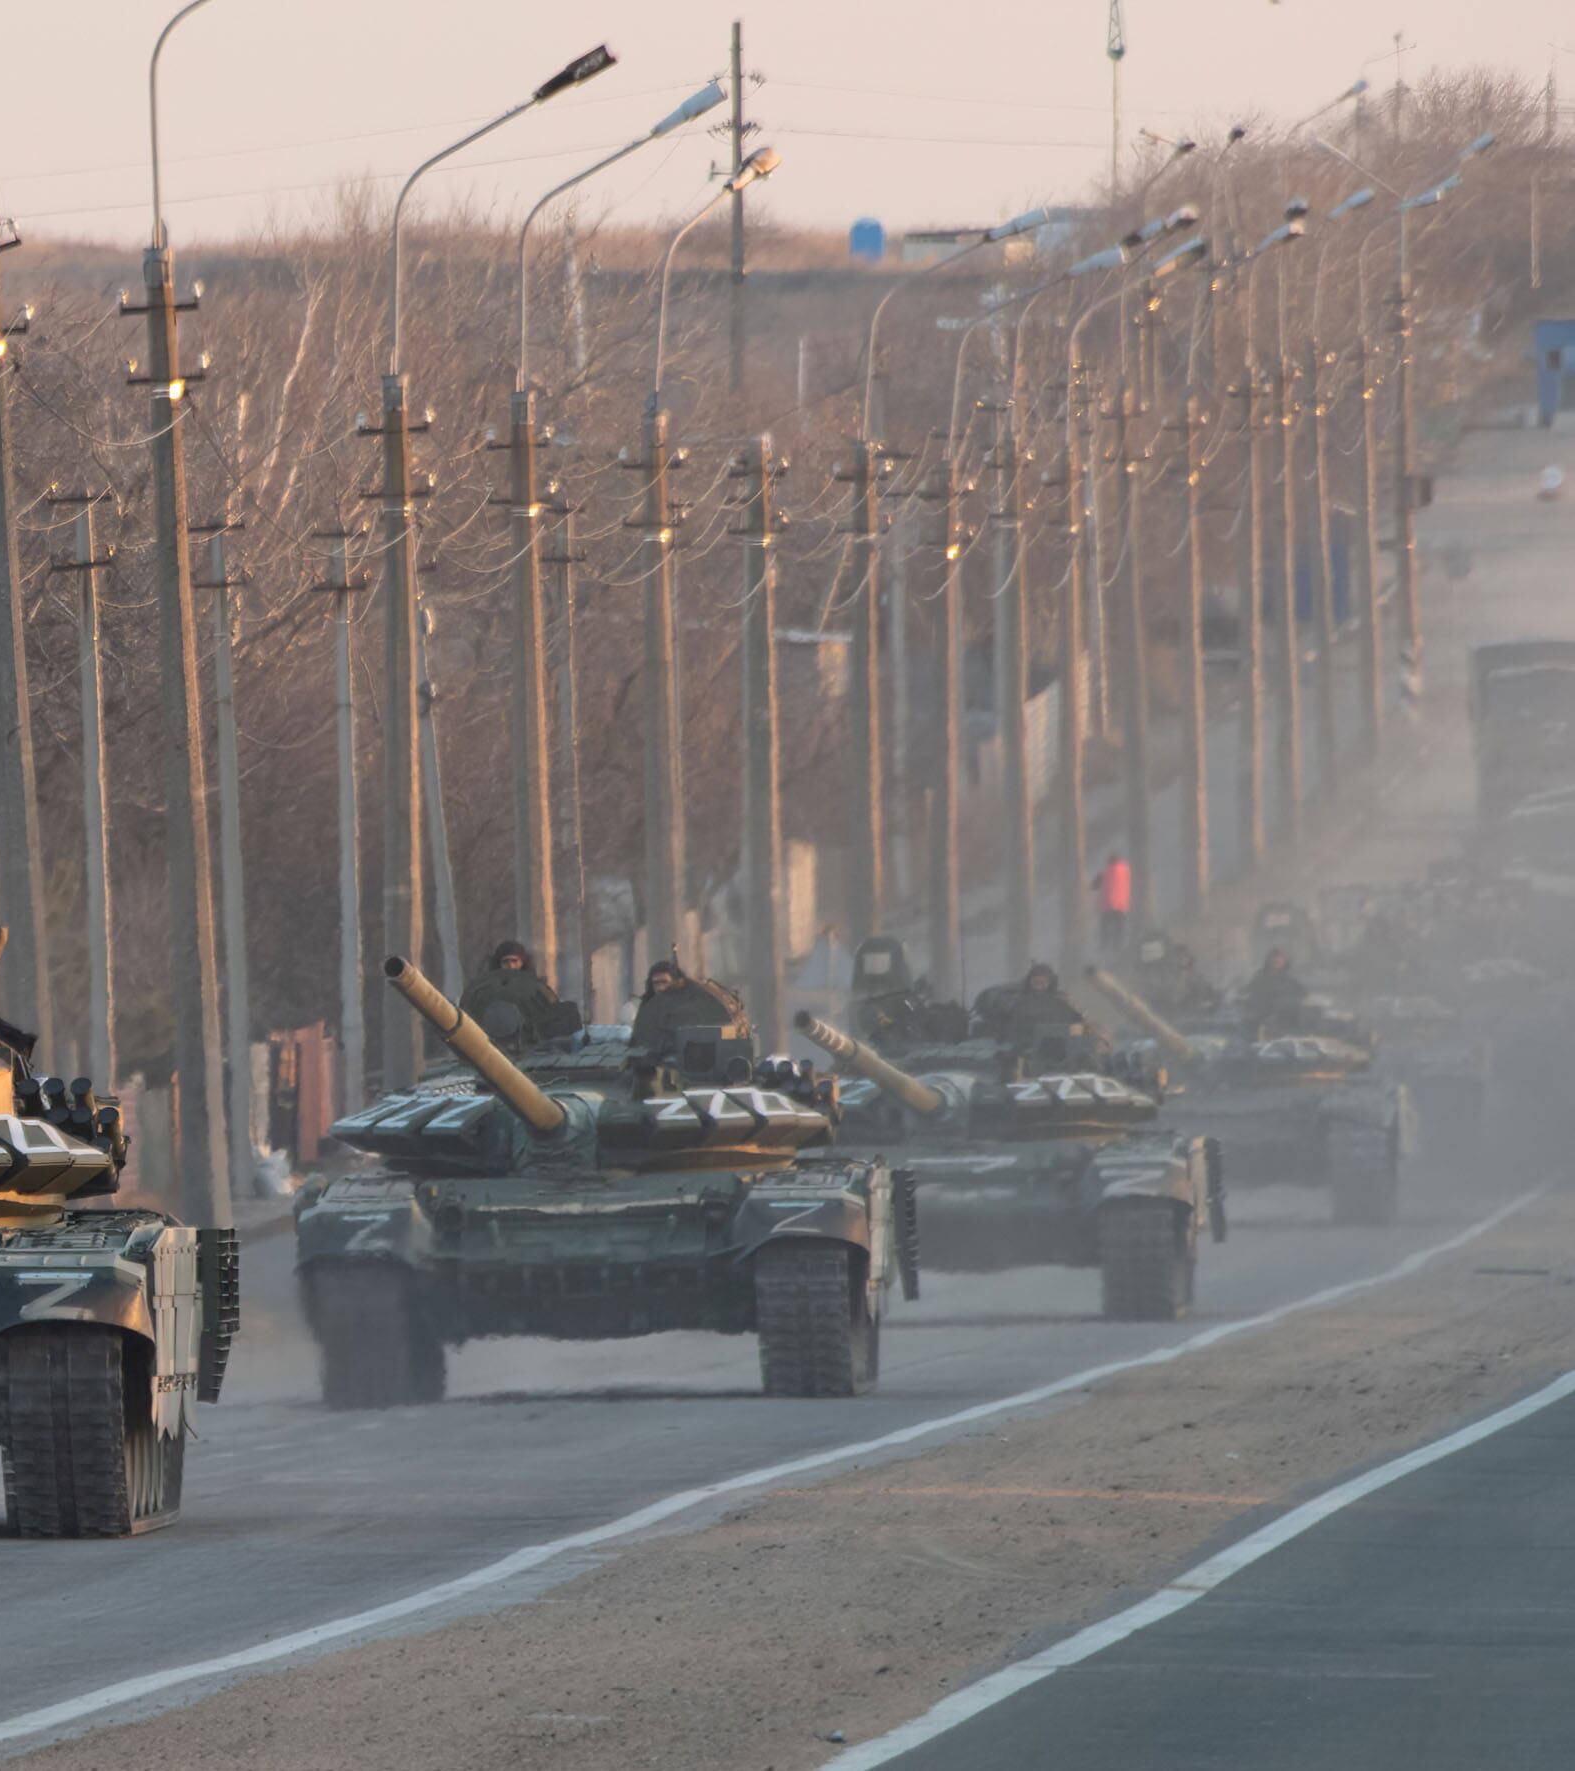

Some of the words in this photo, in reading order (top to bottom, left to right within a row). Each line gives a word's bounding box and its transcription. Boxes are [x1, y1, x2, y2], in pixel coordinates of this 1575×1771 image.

[1099, 1168, 1165, 1197] Z
[342, 1213, 392, 1250] Z
[768, 1201, 824, 1233] Z
[14, 1272, 94, 1321] Z
